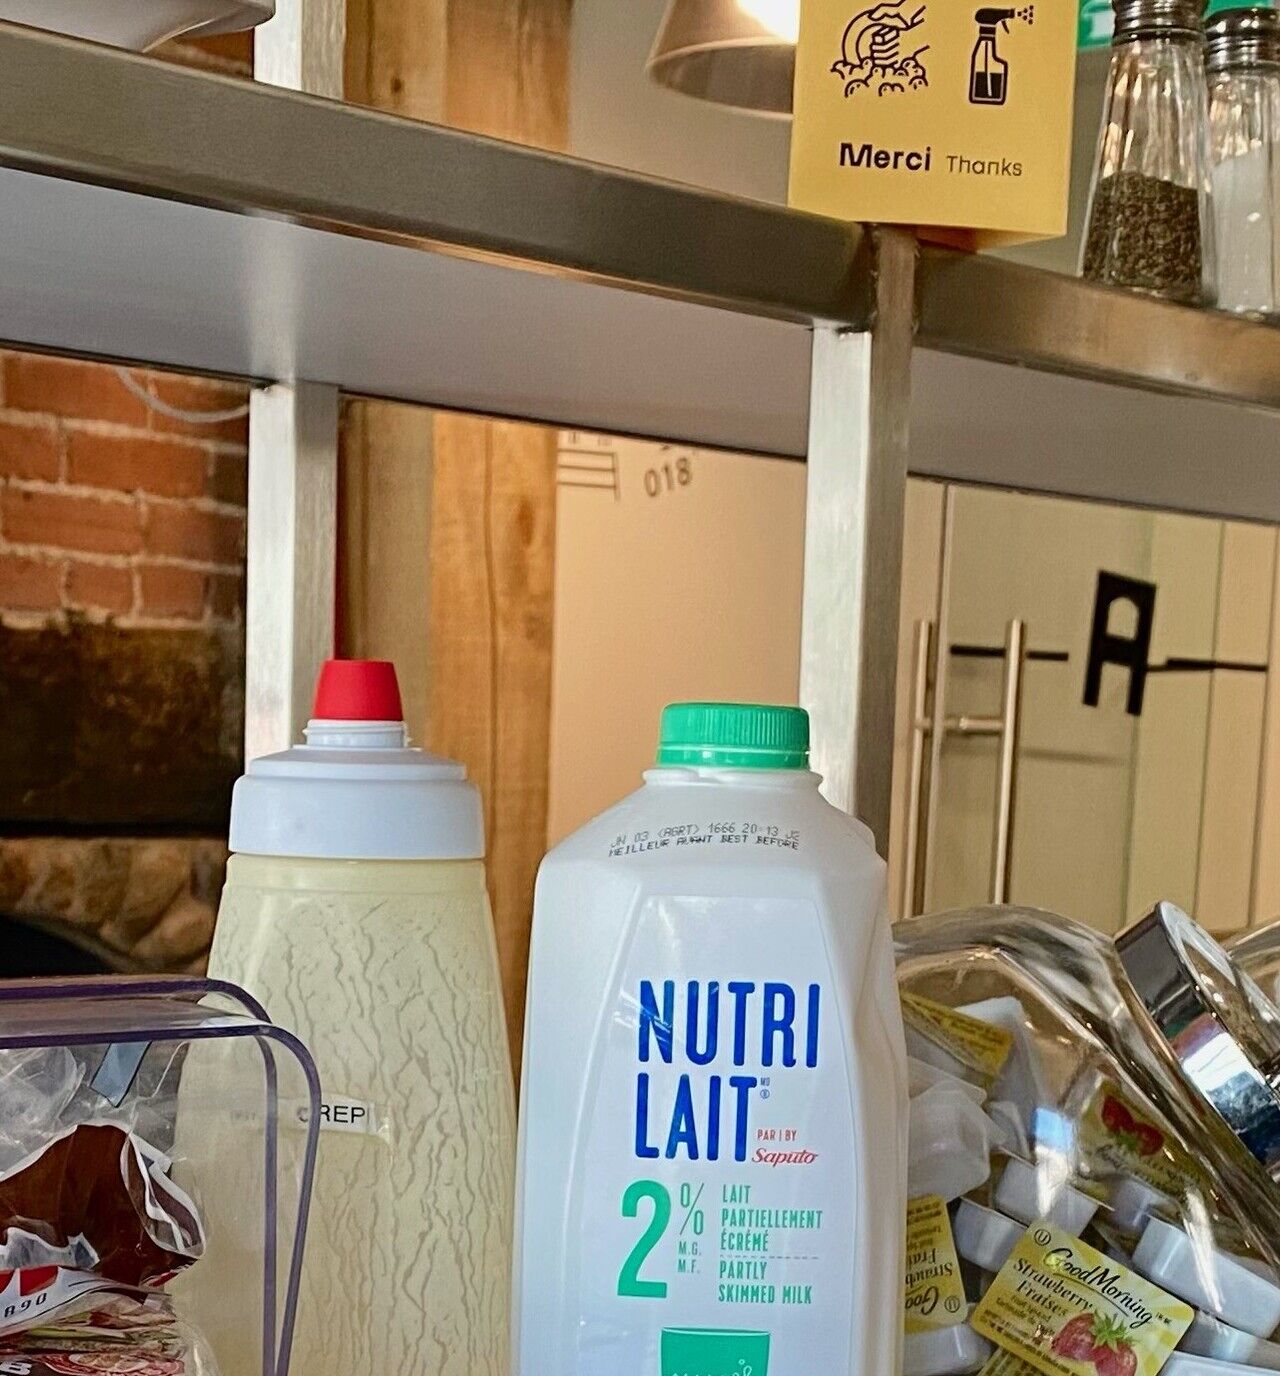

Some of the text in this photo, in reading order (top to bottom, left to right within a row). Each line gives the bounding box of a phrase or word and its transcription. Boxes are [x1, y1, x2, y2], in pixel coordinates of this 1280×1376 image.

[838, 142, 1024, 178] Merci Thanks
[644, 457, 692, 498] 018
[720, 833, 749, 845] BEST
[755, 835, 799, 851] BEFORE
[638, 980, 820, 1068] NUTRI
[635, 1072, 757, 1162] LAIT
[757, 1129, 797, 1142] PAR BY
[751, 1147, 818, 1168] Saputo
[723, 1184, 751, 1205] LAIT
[721, 1208, 823, 1229] PARTIELLEMENT
[617, 1180, 671, 1299] 2
[678, 1241, 702, 1256] M.G.
[720, 1229, 769, 1252] ÉCRÉMÉ
[677, 1259, 701, 1274] M.F.
[719, 1260, 767, 1280] PARTLY
[718, 1284, 813, 1304] SKIMMED MILK
[1013, 1257, 1093, 1310] Strawberry
